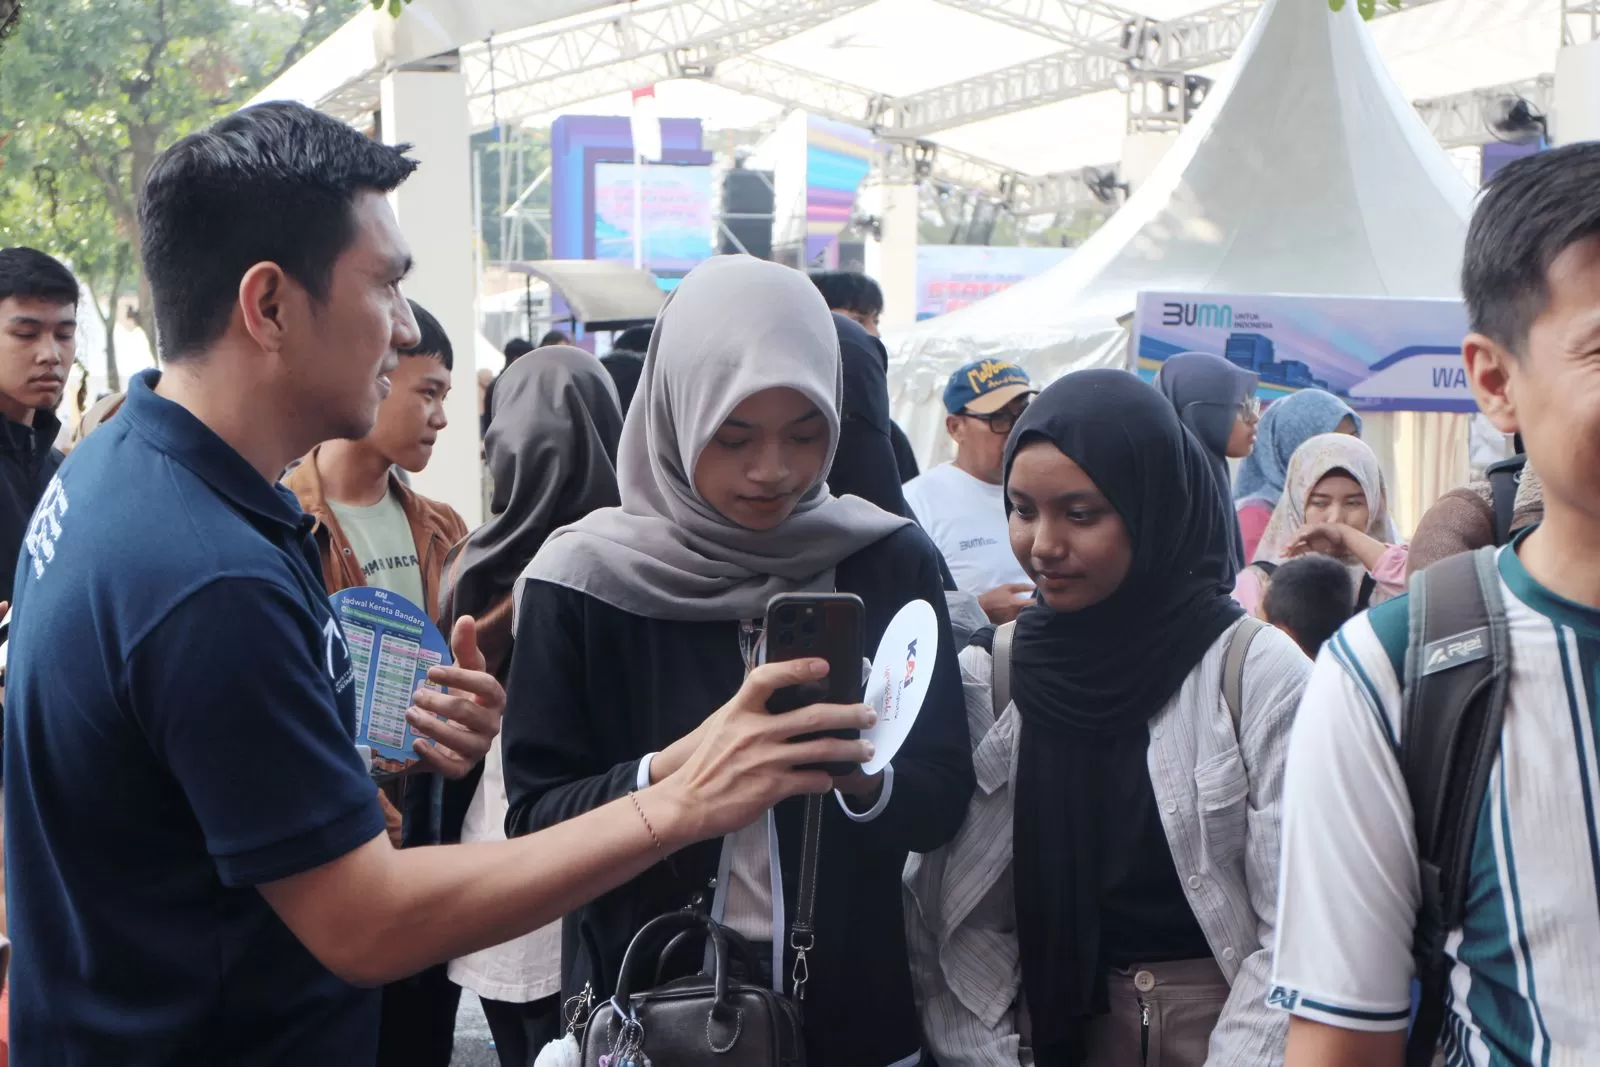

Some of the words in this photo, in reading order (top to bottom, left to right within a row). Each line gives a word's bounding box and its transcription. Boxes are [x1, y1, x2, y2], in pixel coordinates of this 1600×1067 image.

[1162, 302, 1232, 329] BUMN
[1234, 321, 1273, 329] INDONESIA
[341, 596, 368, 608] Jadwal
[368, 600, 393, 614] Kereta
[394, 608, 425, 627] Bandara
